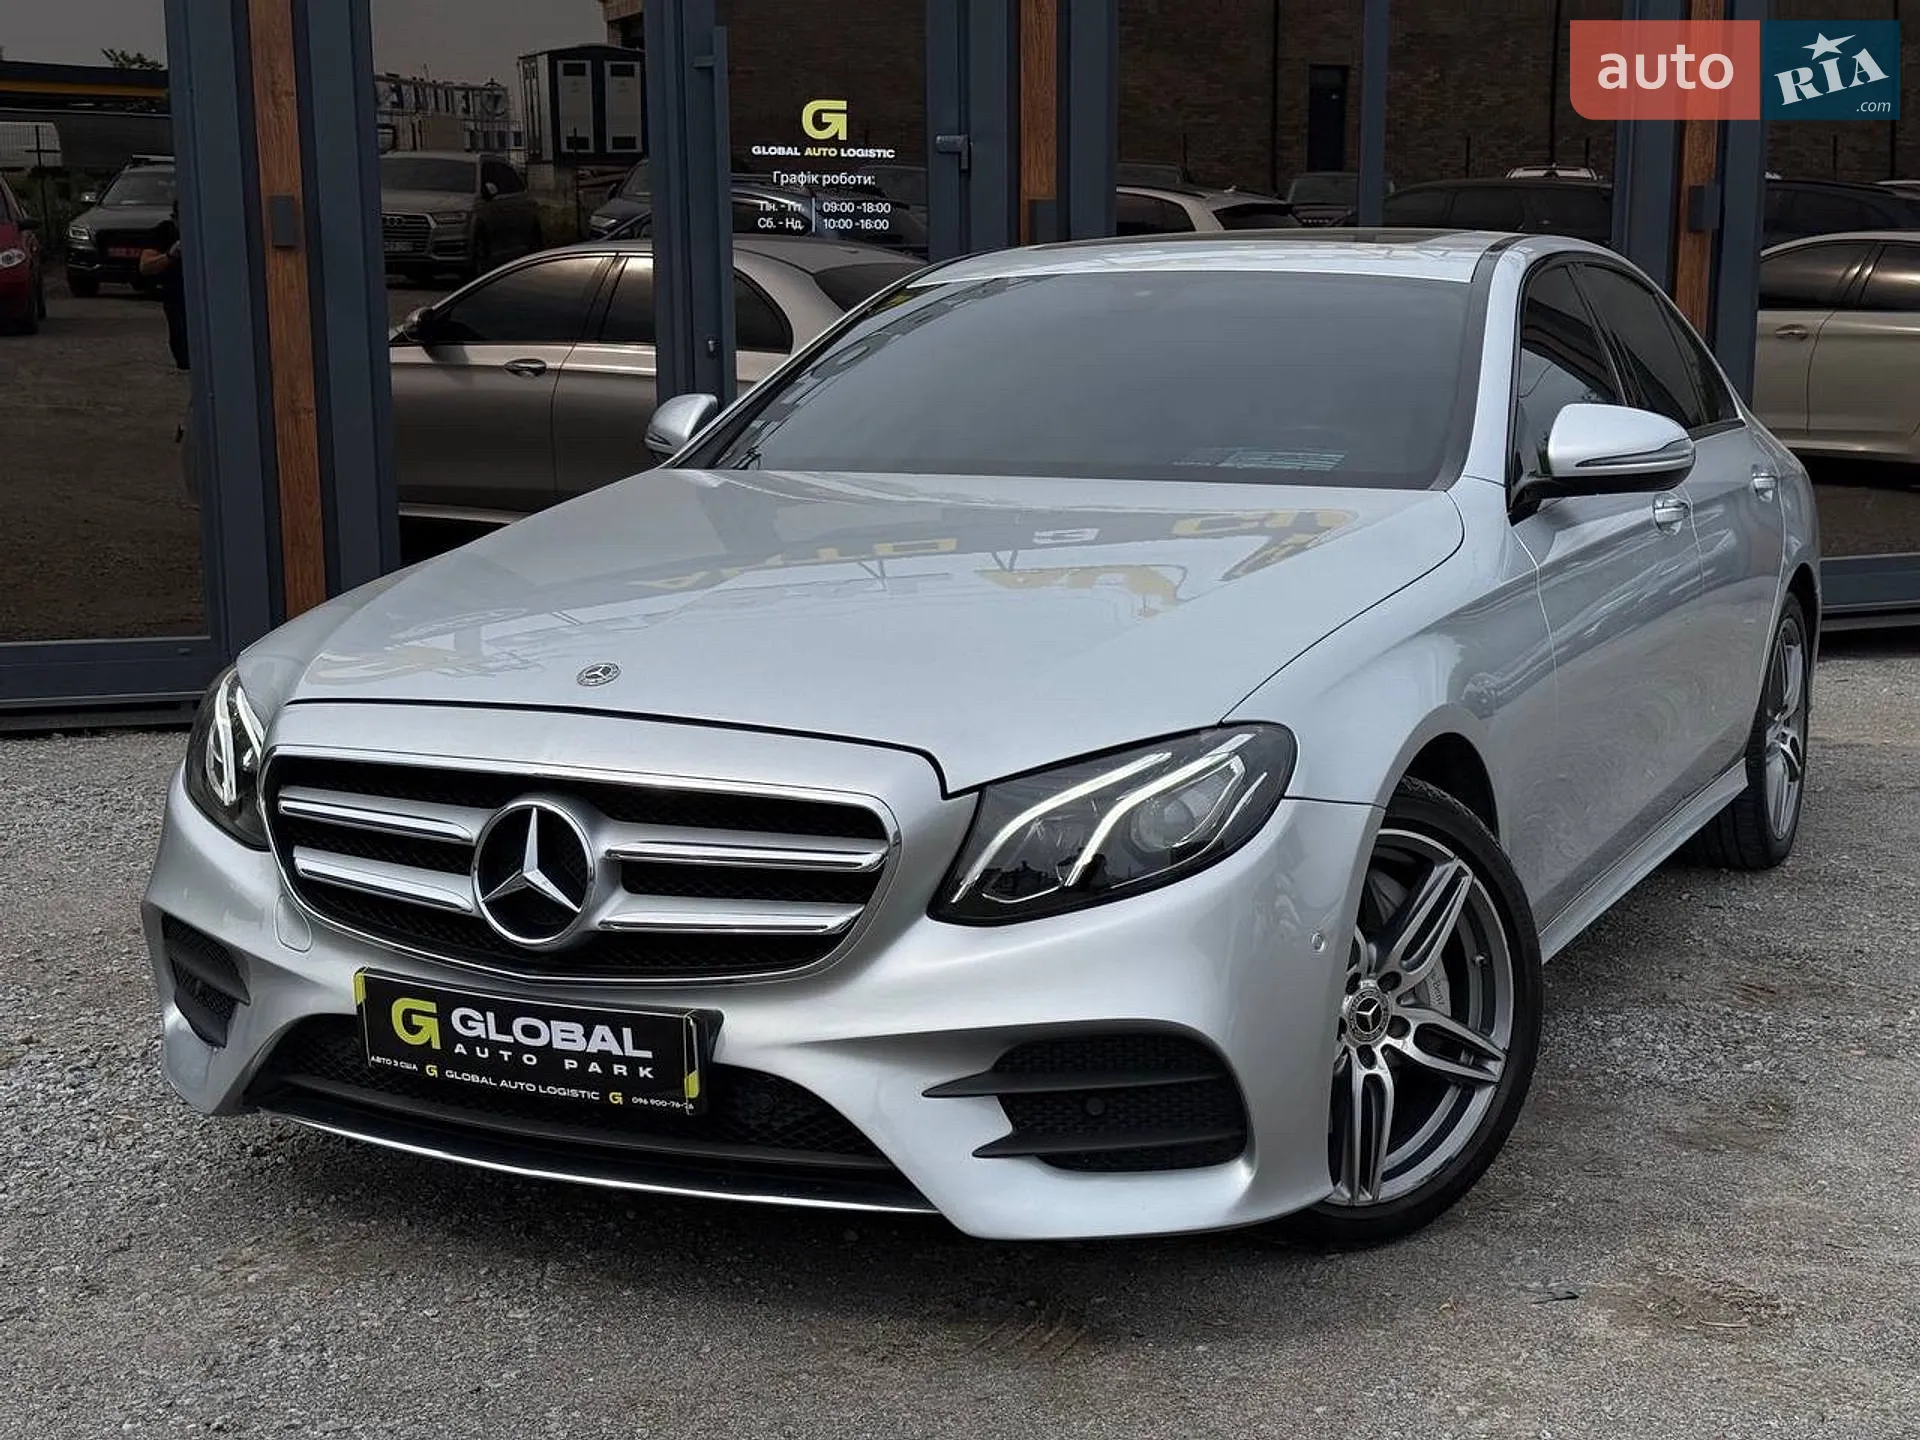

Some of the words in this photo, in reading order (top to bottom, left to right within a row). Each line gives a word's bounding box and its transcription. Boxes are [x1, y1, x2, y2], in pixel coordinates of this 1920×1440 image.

[751, 145, 801, 157] GLOBAL
[804, 146, 838, 157] AUTO
[840, 147, 896, 159] LOGISTIC
[772, 170, 820, 186] Графік
[822, 171, 876, 187] роботи:
[822, 201, 855, 213] 09:00
[757, 217, 777, 229] Сб.
[823, 217, 853, 230] 10:00
[450, 1007, 653, 1059] GLOBAL
[453, 1043, 539, 1066] AUTO
[564, 1059, 655, 1079] PARK
[445, 1069, 497, 1087] GLOBAL
[499, 1079, 536, 1093] AUTO
[539, 1085, 600, 1101] LOGISTIC
